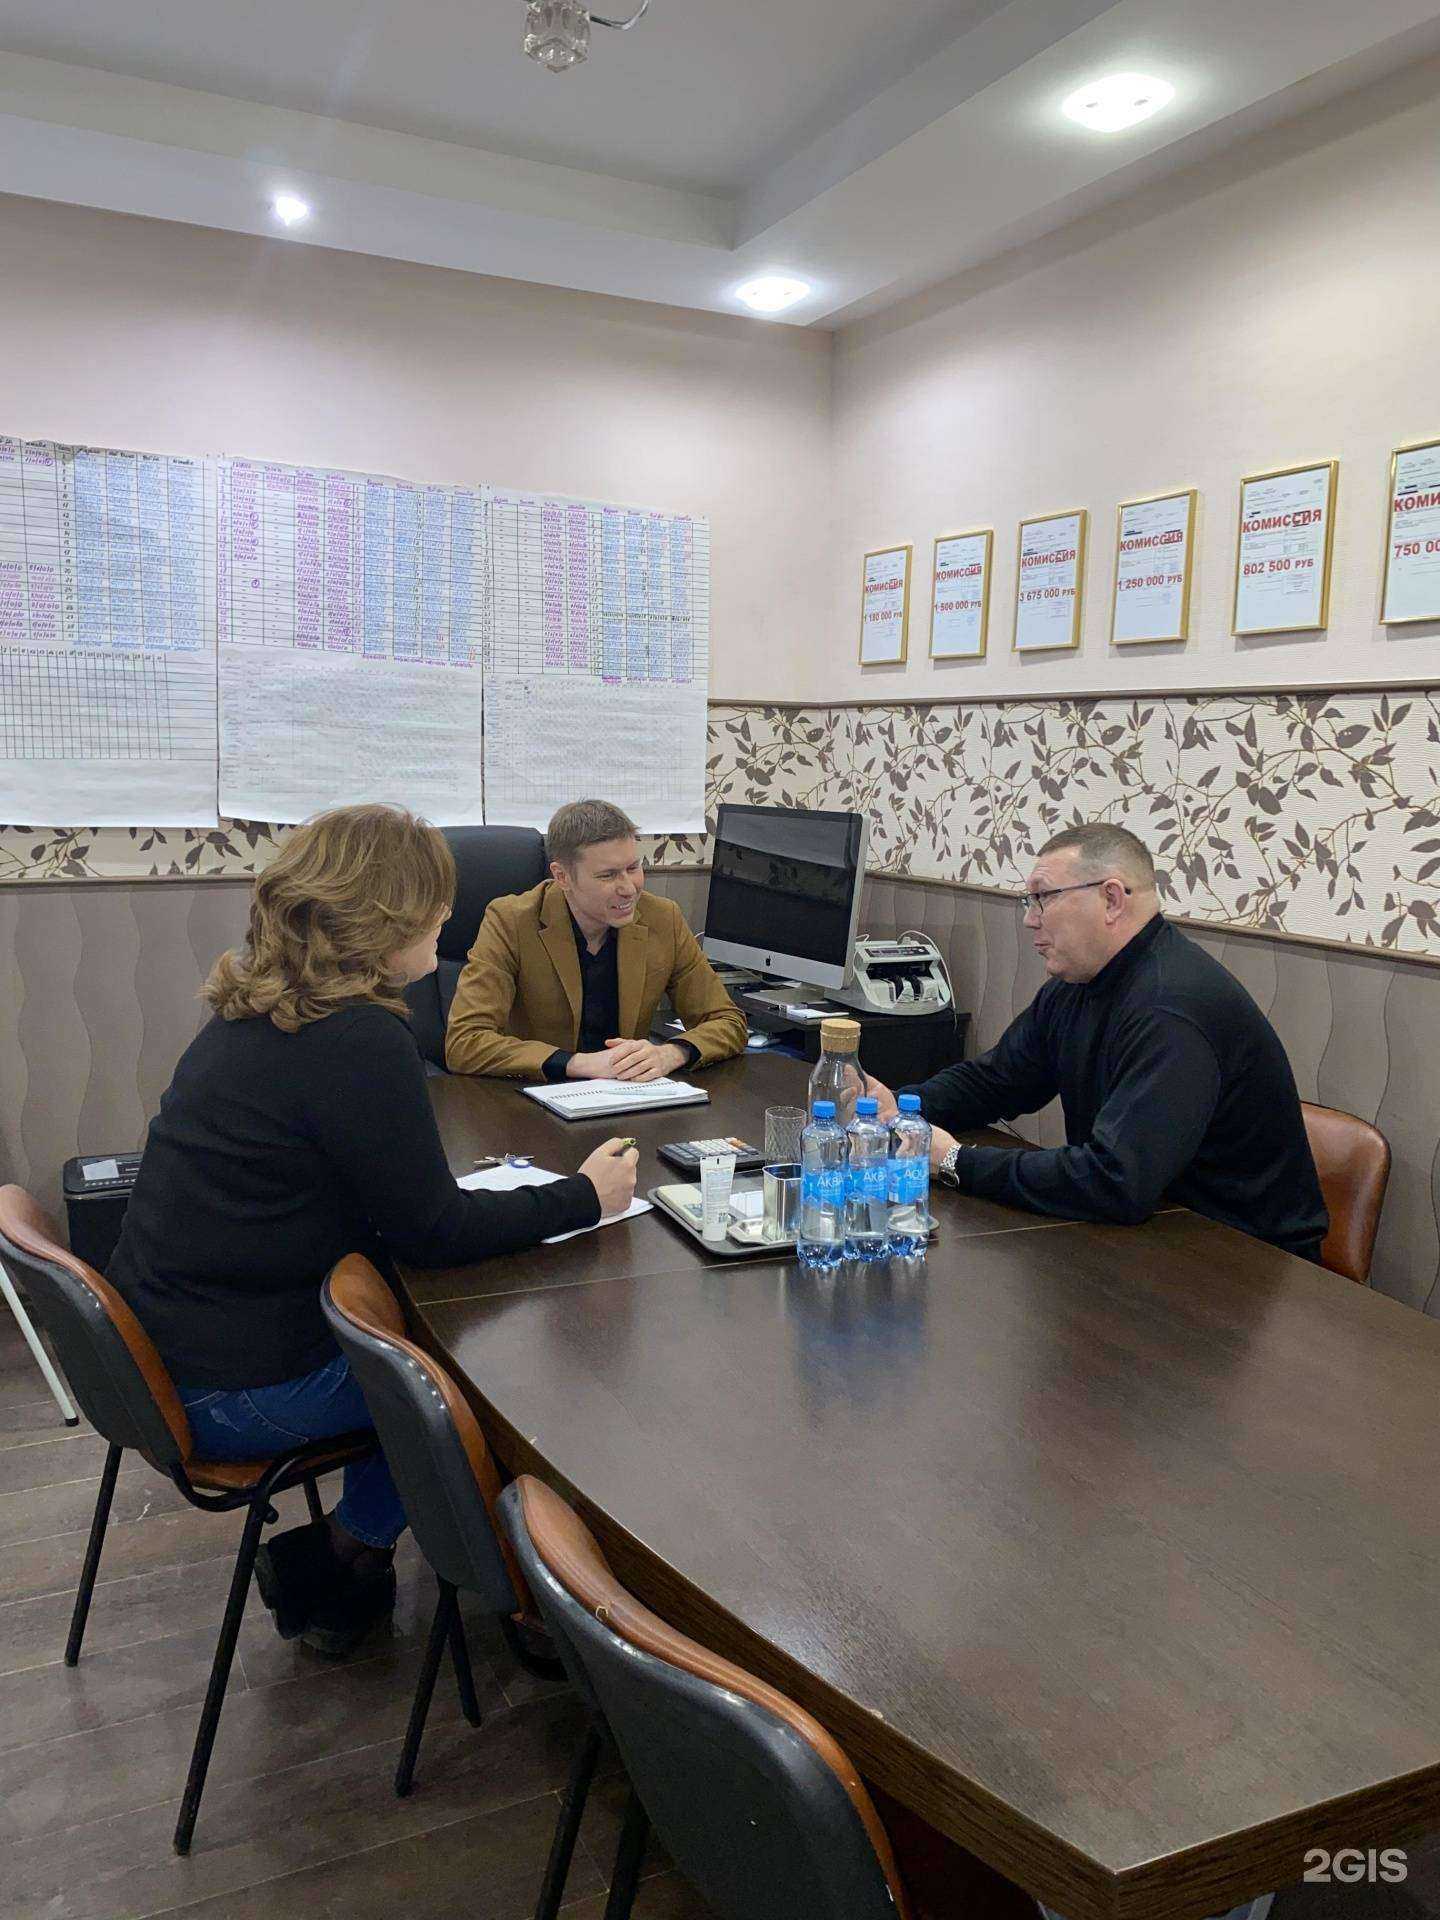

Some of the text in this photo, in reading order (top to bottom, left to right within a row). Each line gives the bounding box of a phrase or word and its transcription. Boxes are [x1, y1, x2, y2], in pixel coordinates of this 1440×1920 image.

[1242, 509, 1322, 533] КОМИССИЯ
[1120, 532, 1184, 551] КОМИССИЯ
[1394, 543, 1420, 557] 750
[1021, 550, 1076, 568] КОМИССИЯ
[936, 566, 982, 580] КОМИССИЯ
[1243, 559, 1314, 575] 802 500 РУБ
[1125, 578, 1144, 589] 250
[1146, 575, 1165, 586] 000
[1167, 574, 1183, 584] РУБ
[1026, 590, 1042, 600] 675
[1044, 588, 1060, 598] 000
[1062, 588, 1076, 597] РУБ
[955, 600, 969, 610] 000
